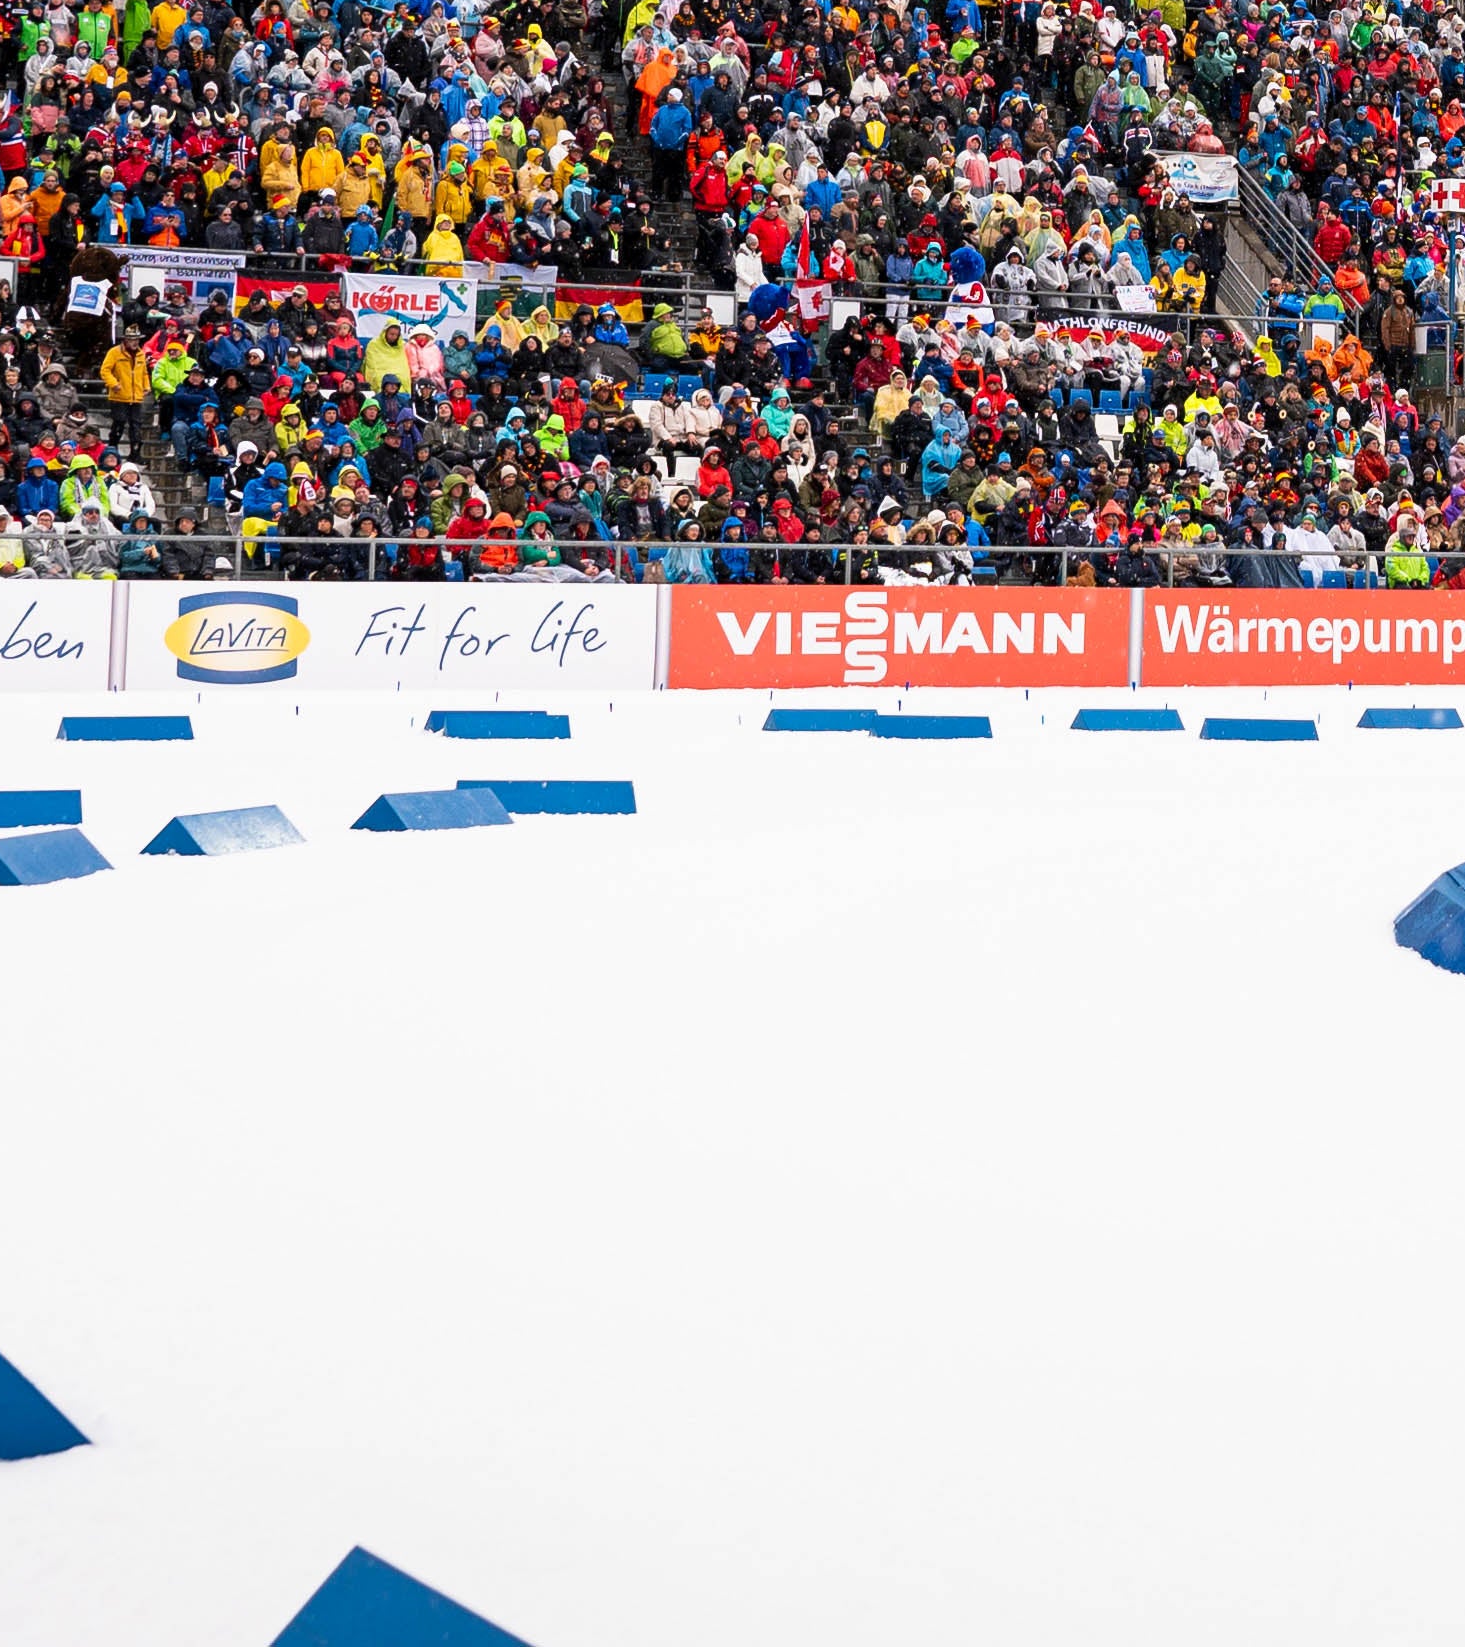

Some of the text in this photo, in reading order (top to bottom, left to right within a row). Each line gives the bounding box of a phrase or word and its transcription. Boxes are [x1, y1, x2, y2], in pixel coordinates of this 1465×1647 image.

[352, 285, 440, 313] KÖRLE
[355, 601, 607, 671] Fit for life
[716, 591, 1086, 683] VIESSMANN
